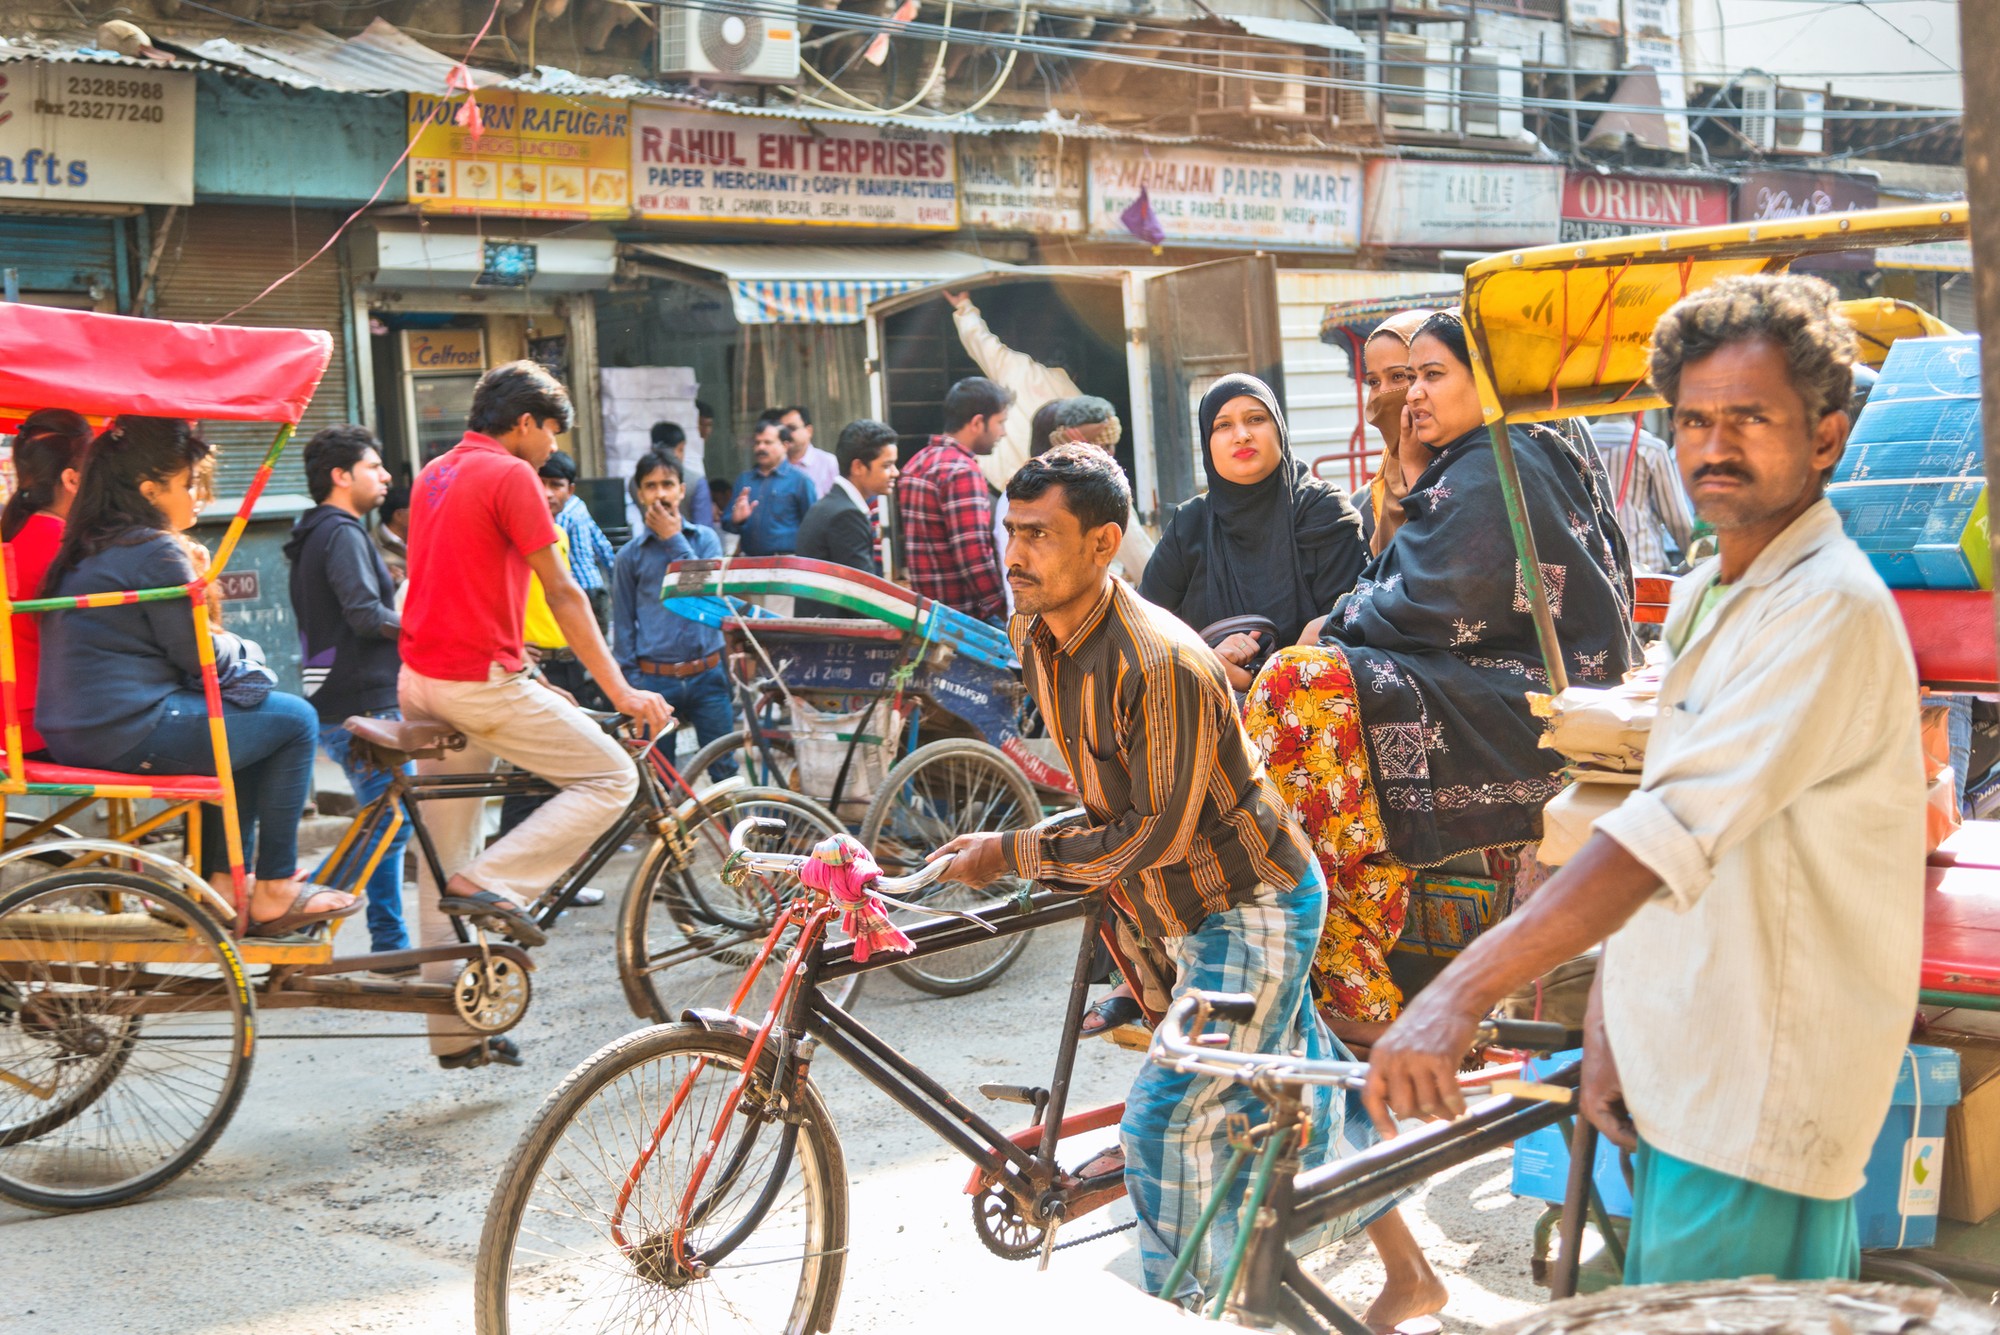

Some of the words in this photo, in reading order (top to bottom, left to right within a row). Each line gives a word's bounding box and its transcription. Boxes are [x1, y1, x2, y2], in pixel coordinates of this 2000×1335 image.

[68, 76, 164, 99] 23285988
[68, 100, 164, 123] 23277240
[522, 106, 628, 138] RAFUGAR
[641, 126, 746, 166] RAHUL
[758, 133, 946, 178] ENTERPRISES
[0, 148, 88, 186] afts
[648, 167, 704, 187] PAPER
[713, 171, 798, 191] MERCHANT
[813, 176, 850, 194] COPY
[1118, 160, 1216, 193] MAHAJAN
[1222, 167, 1282, 198] PAPER
[1293, 172, 1351, 203] MART
[639, 194, 659, 209] NEW
[1579, 175, 1706, 225] ORIENT
[1562, 221, 1624, 240] PAPER
